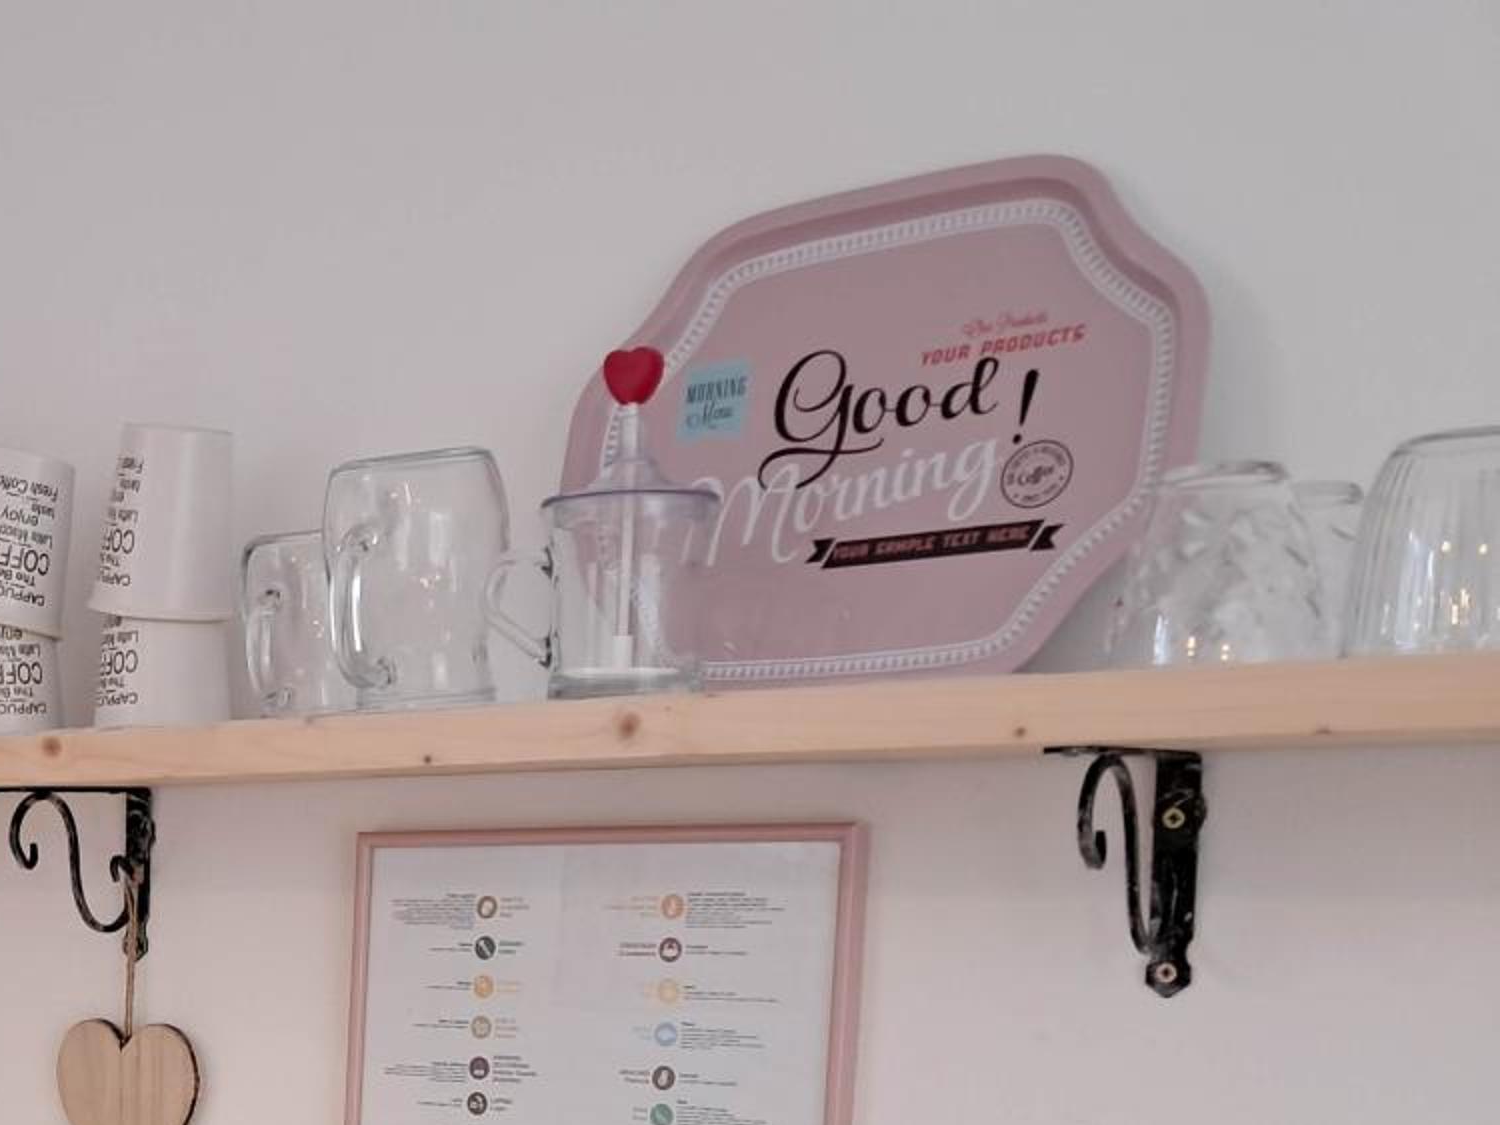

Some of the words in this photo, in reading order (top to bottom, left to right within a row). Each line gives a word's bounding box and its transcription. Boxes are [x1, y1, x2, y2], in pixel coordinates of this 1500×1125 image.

[922, 344, 971, 366] YOUR
[981, 323, 1087, 355] PRODUCTS
[686, 376, 748, 403] MORNING
[30, 481, 58, 502] Fresh
[690, 438, 997, 567] Morning
[1, 505, 38, 526] enjoy
[831, 541, 869, 561] YOUR
[942, 530, 980, 549] TEXT
[986, 523, 1031, 544] HERE
[16, 571, 35, 587] The
